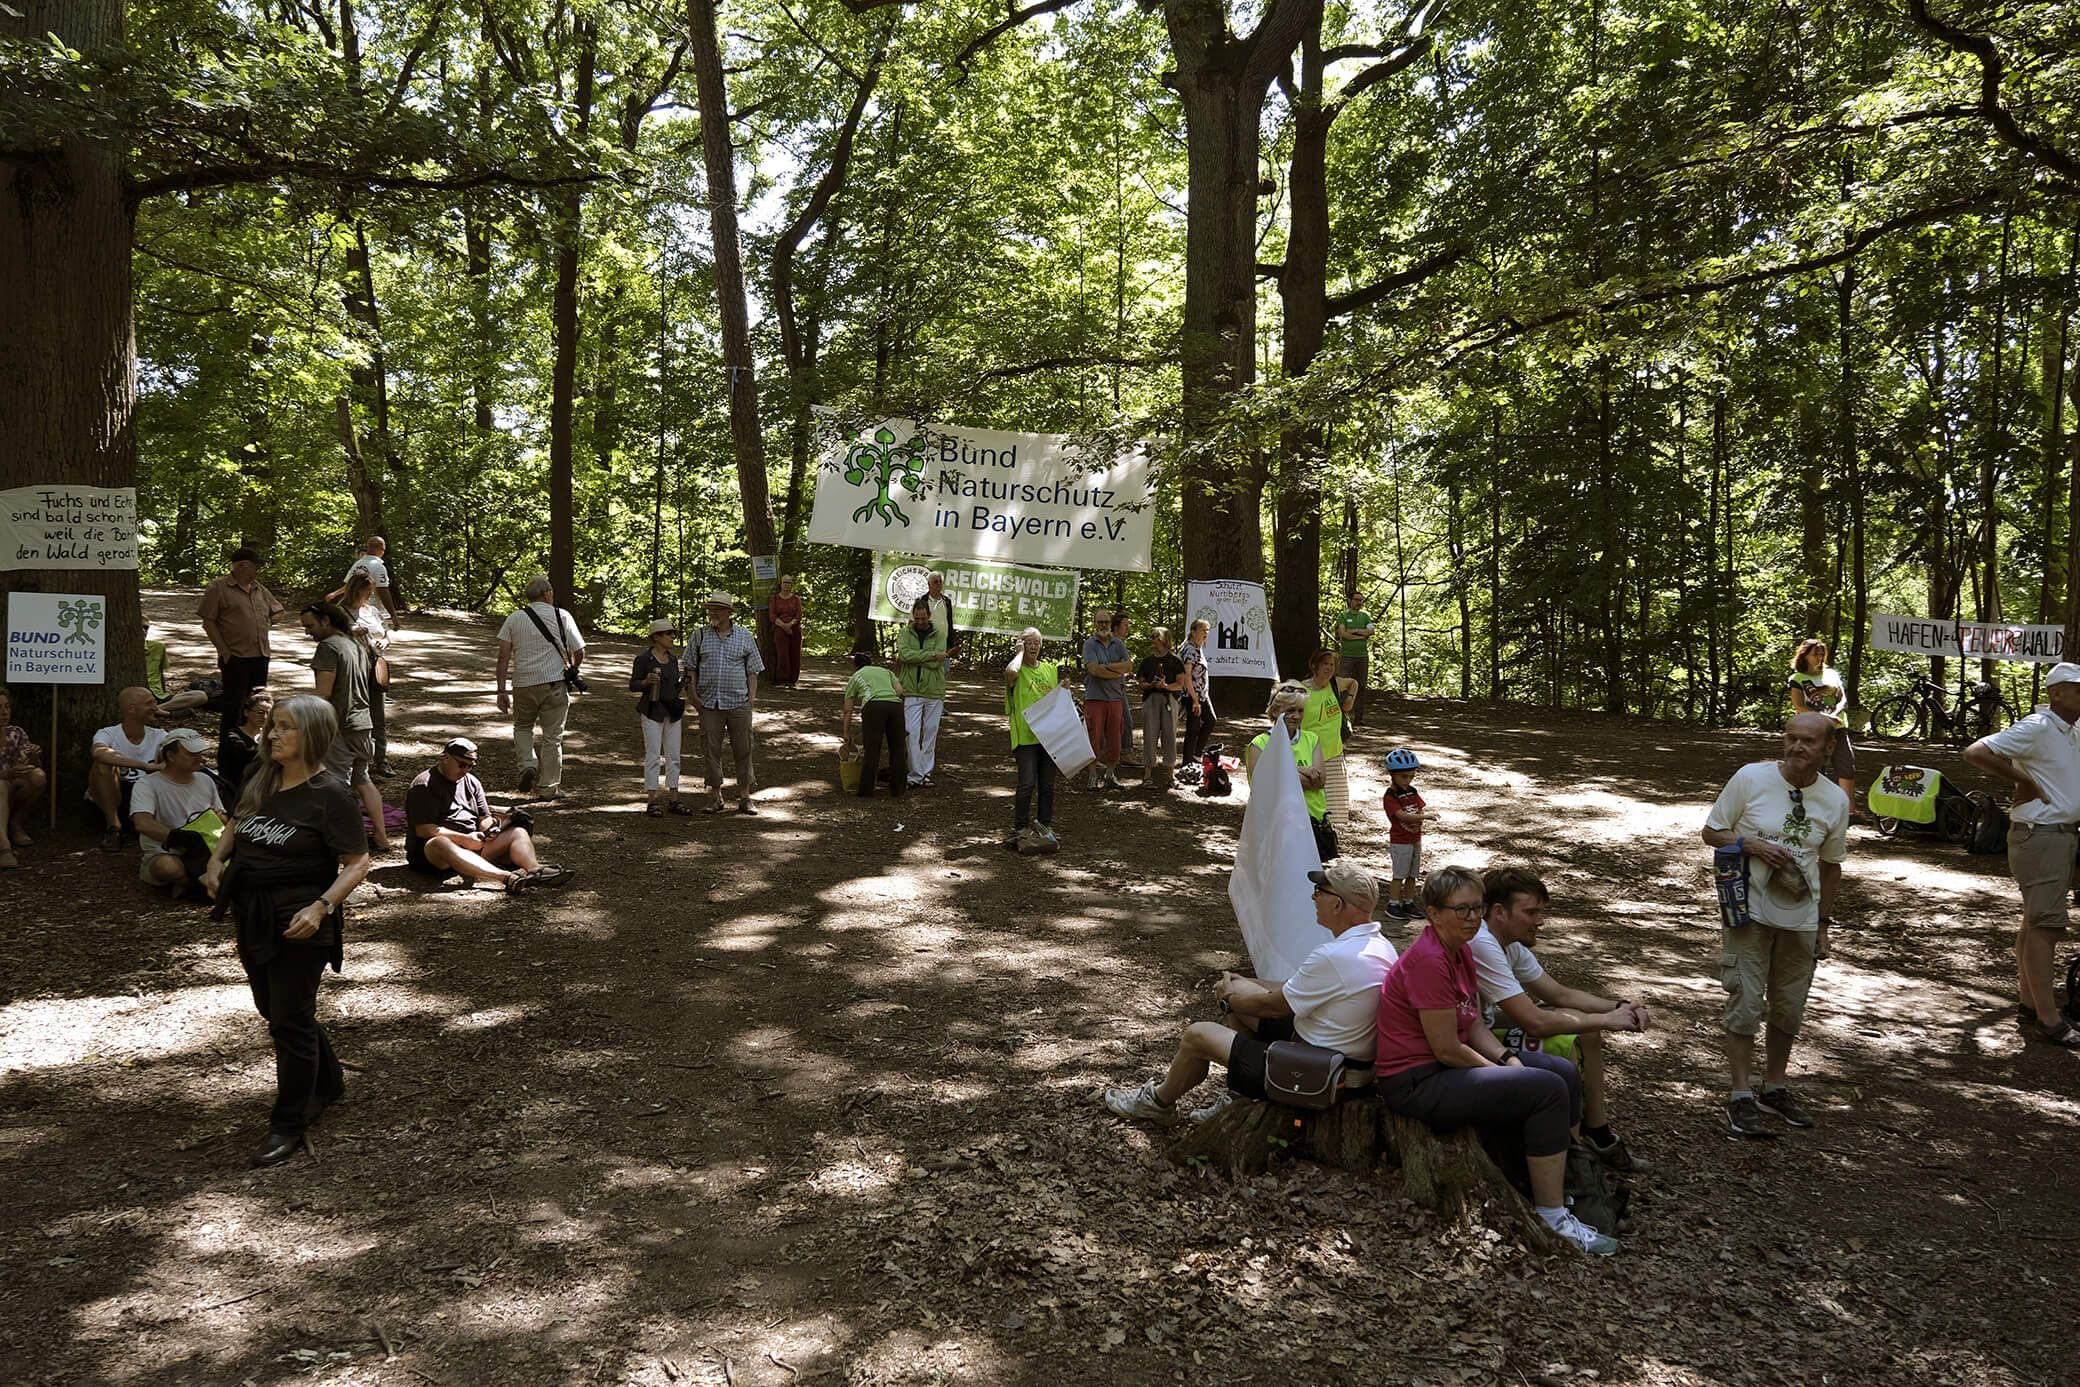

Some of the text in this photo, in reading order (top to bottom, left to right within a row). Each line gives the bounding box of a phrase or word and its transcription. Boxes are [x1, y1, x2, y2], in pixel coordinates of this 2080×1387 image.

[940, 436, 1017, 468] Bund
[938, 470, 1116, 509] Naturschutz
[37, 492, 84, 509] Fuchs
[90, 494, 110, 508] und
[11, 509, 40, 522] sind
[46, 509, 82, 524] bald
[86, 511, 124, 523] schon
[935, 502, 1126, 541] in Bayern e.V.
[44, 527, 75, 541] weil
[83, 527, 104, 542] die
[16, 544, 39, 560] den
[47, 542, 89, 560] Wald
[945, 568, 1067, 599] REICHSWALD
[891, 593, 913, 610] BLEIB
[944, 589, 1050, 619] BLEIBT E.V.
[10, 631, 61, 644] BUND
[1888, 621, 1944, 649] HAFEN
[2022, 630, 2065, 657] WALD
[9, 647, 97, 660] Naturschutz
[9, 660, 97, 675] in Bayern e.V.
